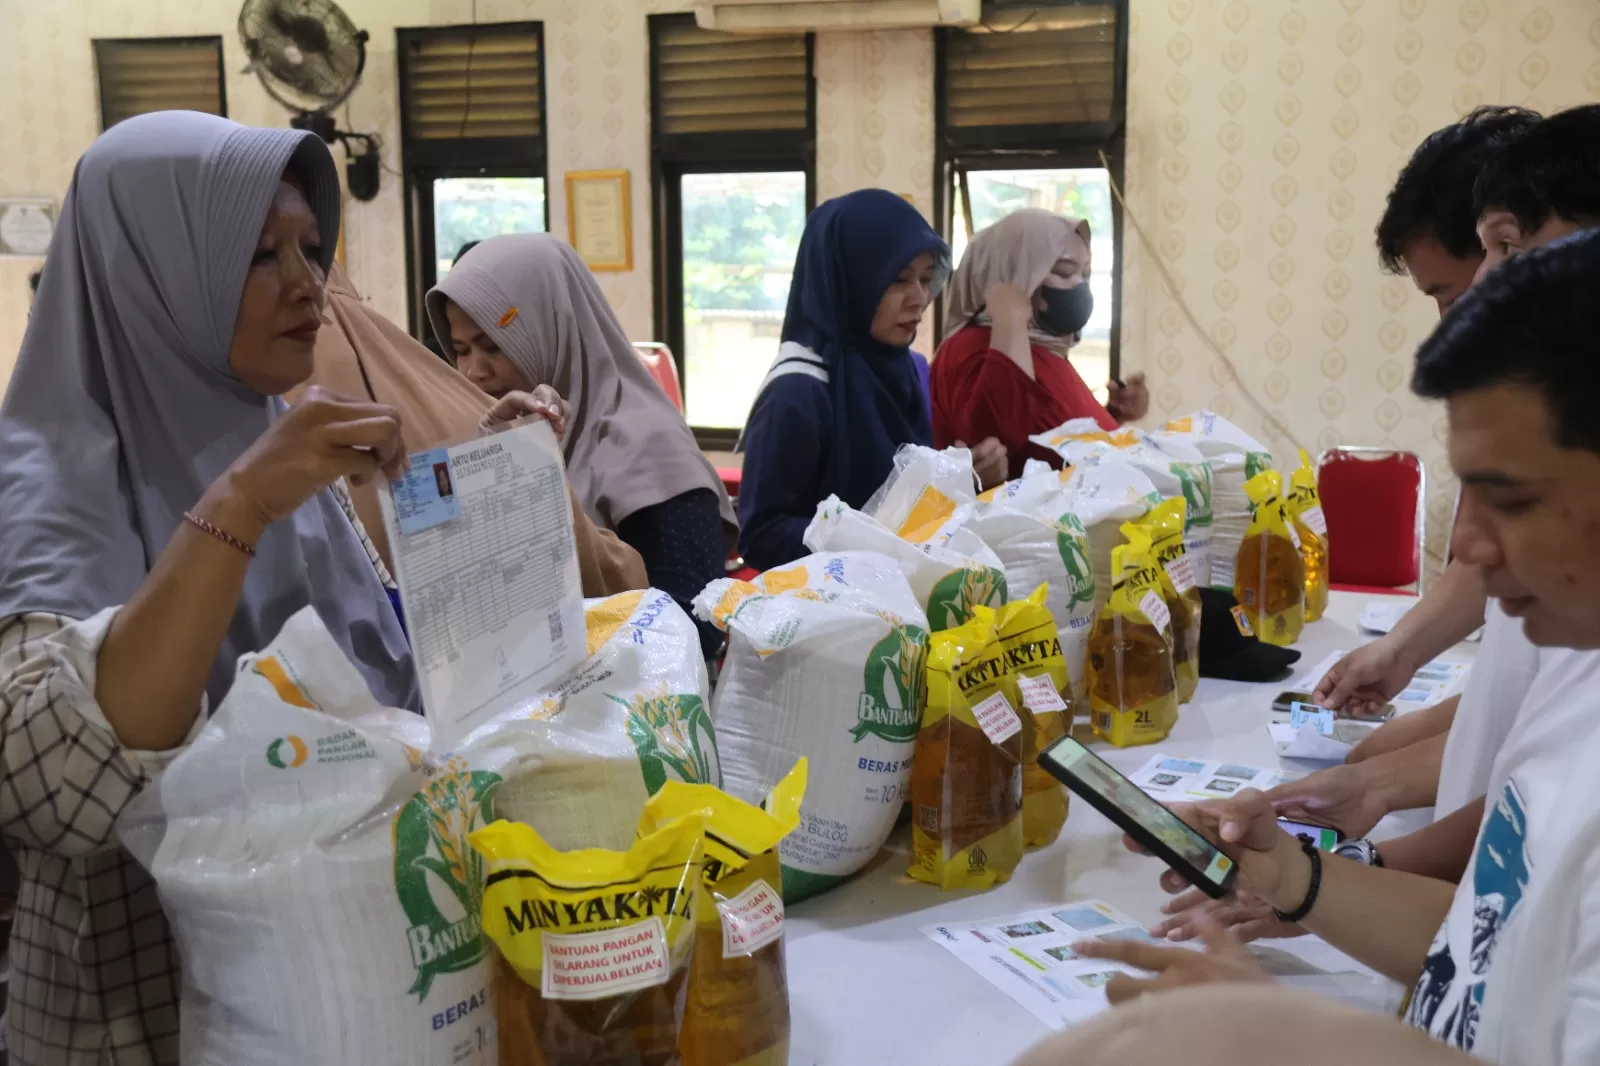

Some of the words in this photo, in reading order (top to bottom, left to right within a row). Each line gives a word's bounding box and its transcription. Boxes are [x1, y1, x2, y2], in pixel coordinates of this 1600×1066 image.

[452, 454, 469, 468] ARTU
[859, 692, 914, 726] BANTUAN
[1135, 710, 1152, 723] 2L
[858, 757, 899, 773] BERAS
[881, 784, 897, 804] 10
[808, 822, 848, 842] BULOG
[407, 912, 482, 969] BANTUA
[550, 943, 599, 957] BANTUAN
[603, 930, 653, 952] PANGAN
[553, 955, 610, 971] DILARANG
[613, 946, 654, 964] UNTUK
[553, 959, 663, 985] DIPERJUALBELIKAN
